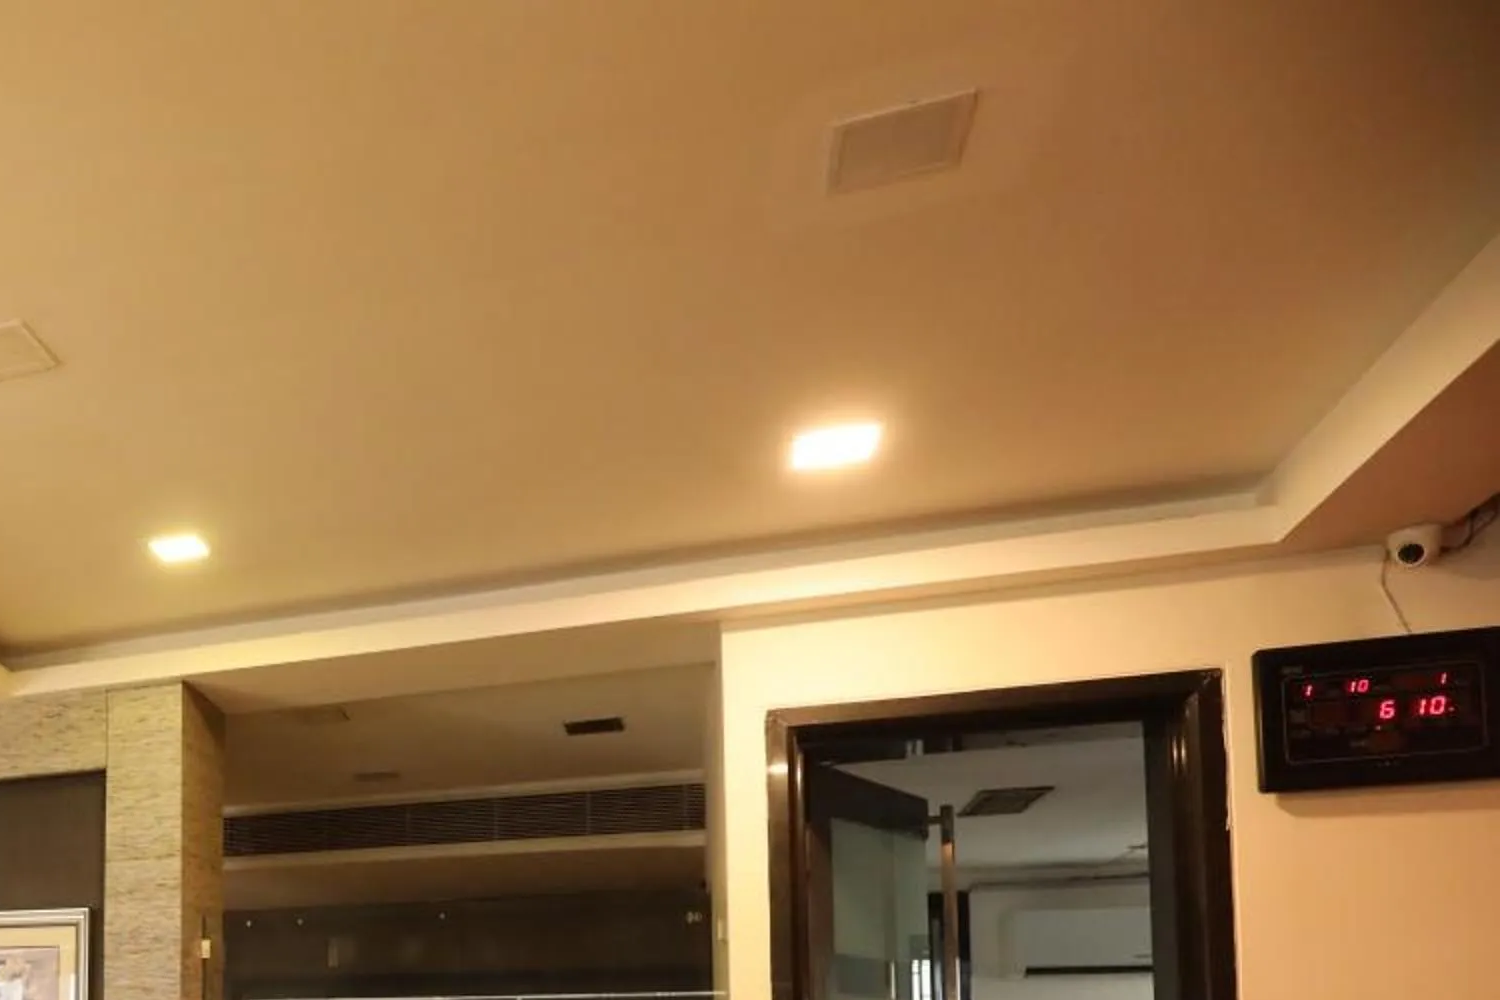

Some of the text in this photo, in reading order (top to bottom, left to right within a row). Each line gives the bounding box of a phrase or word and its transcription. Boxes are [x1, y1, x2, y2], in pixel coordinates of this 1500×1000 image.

[1350, 679, 1369, 693] 10
[1379, 695, 1446, 719] 6 10
